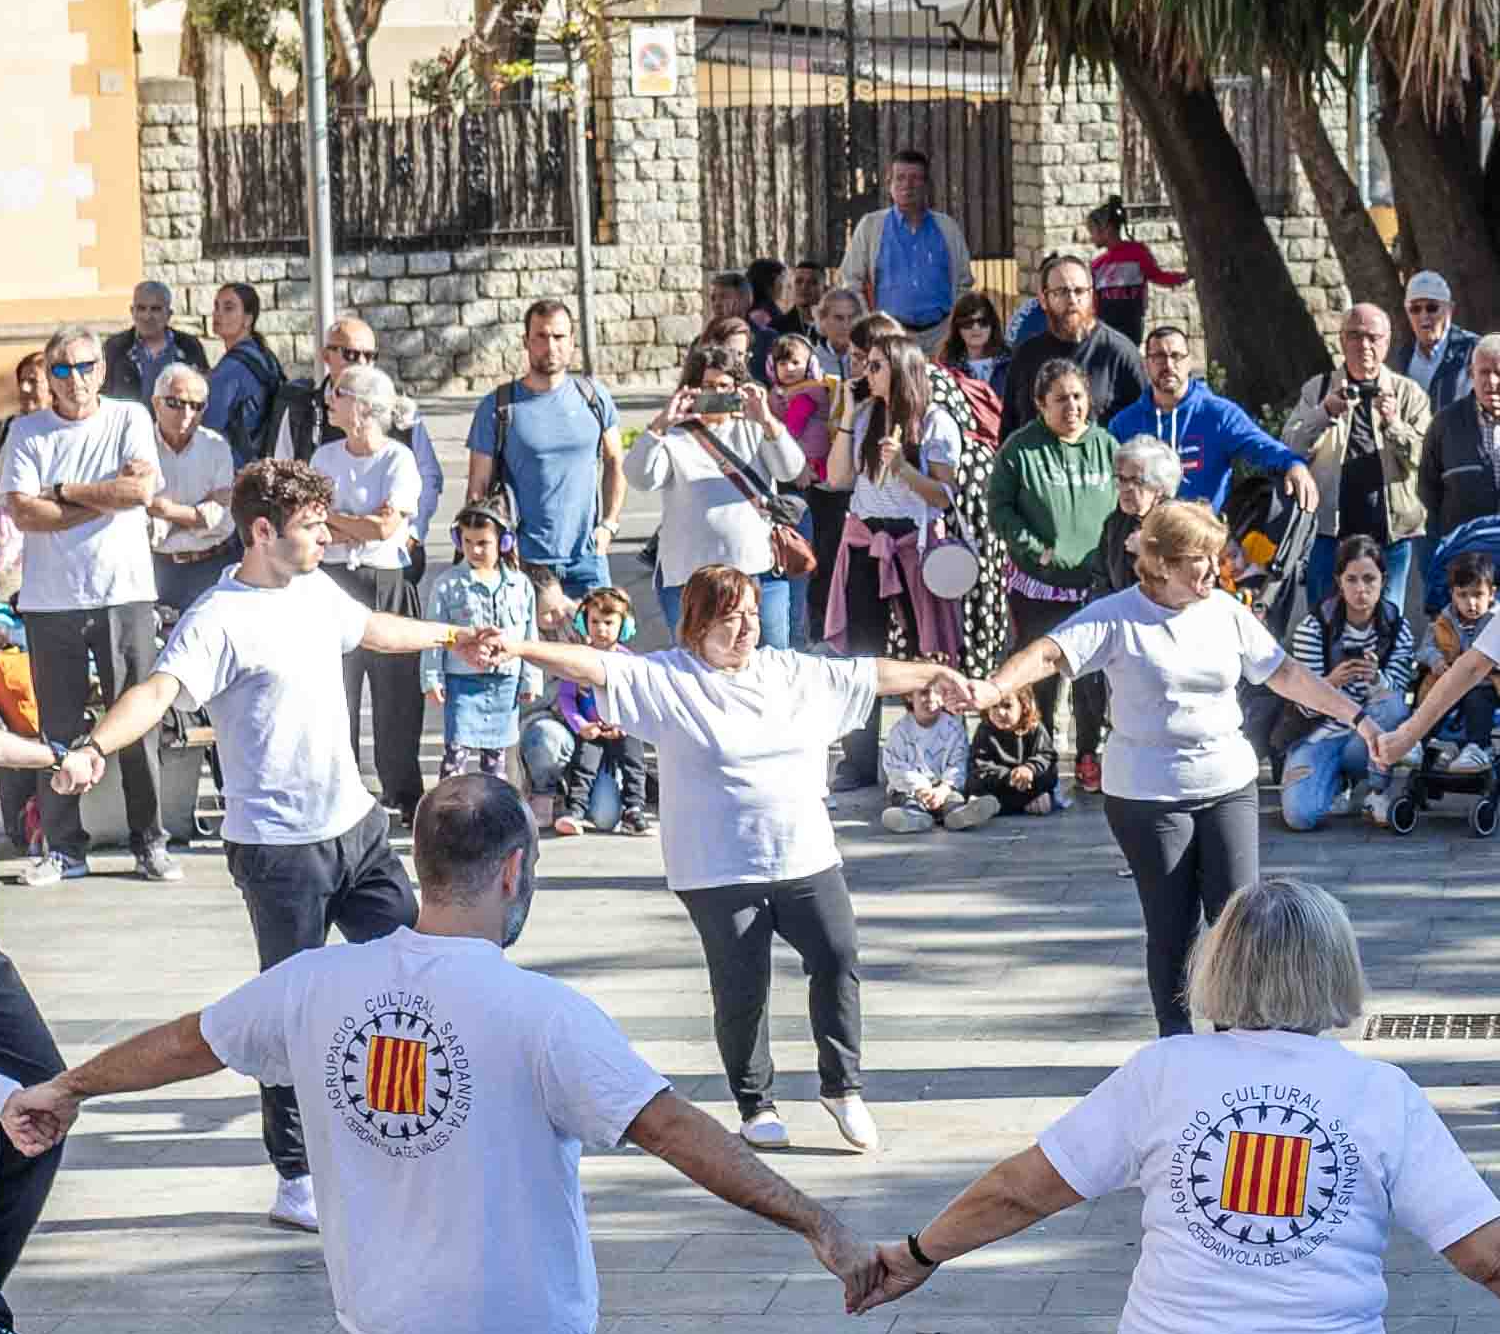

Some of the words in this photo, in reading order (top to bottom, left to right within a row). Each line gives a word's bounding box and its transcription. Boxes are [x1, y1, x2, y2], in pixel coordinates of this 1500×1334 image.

[440, 1021, 472, 1129] SARDANISTA
[1221, 1085, 1321, 1114] CULTURAL
[1329, 1118, 1360, 1225] SARDANISTA
[1187, 1221, 1261, 1267] CERDANYOLA
[1264, 1251, 1290, 1267] DEL
